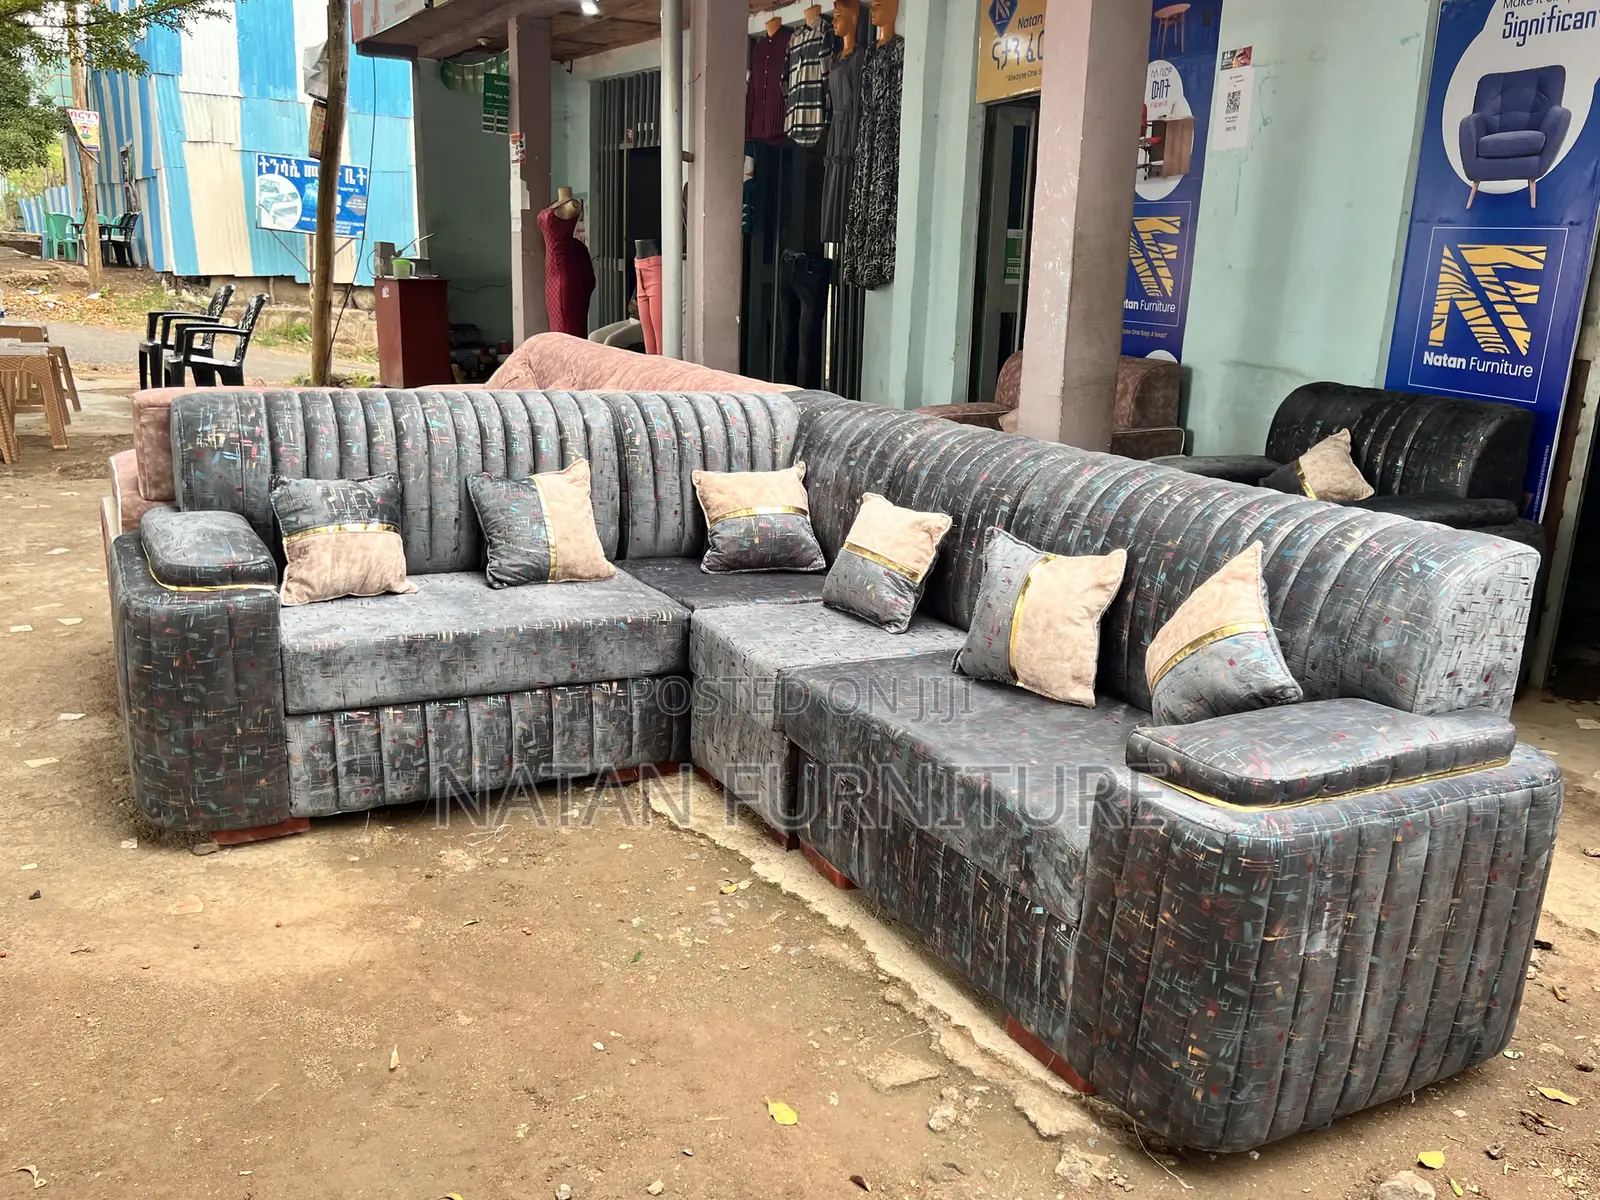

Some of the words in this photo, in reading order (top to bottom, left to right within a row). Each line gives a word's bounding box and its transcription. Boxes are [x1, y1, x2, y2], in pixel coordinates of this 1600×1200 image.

[1017, 14, 1043, 30] Natan
[1502, 5, 1600, 47] Significan
[1140, 299, 1176, 313] Furniture
[1423, 351, 1466, 370] Natan
[1469, 356, 1534, 378] Furniture
